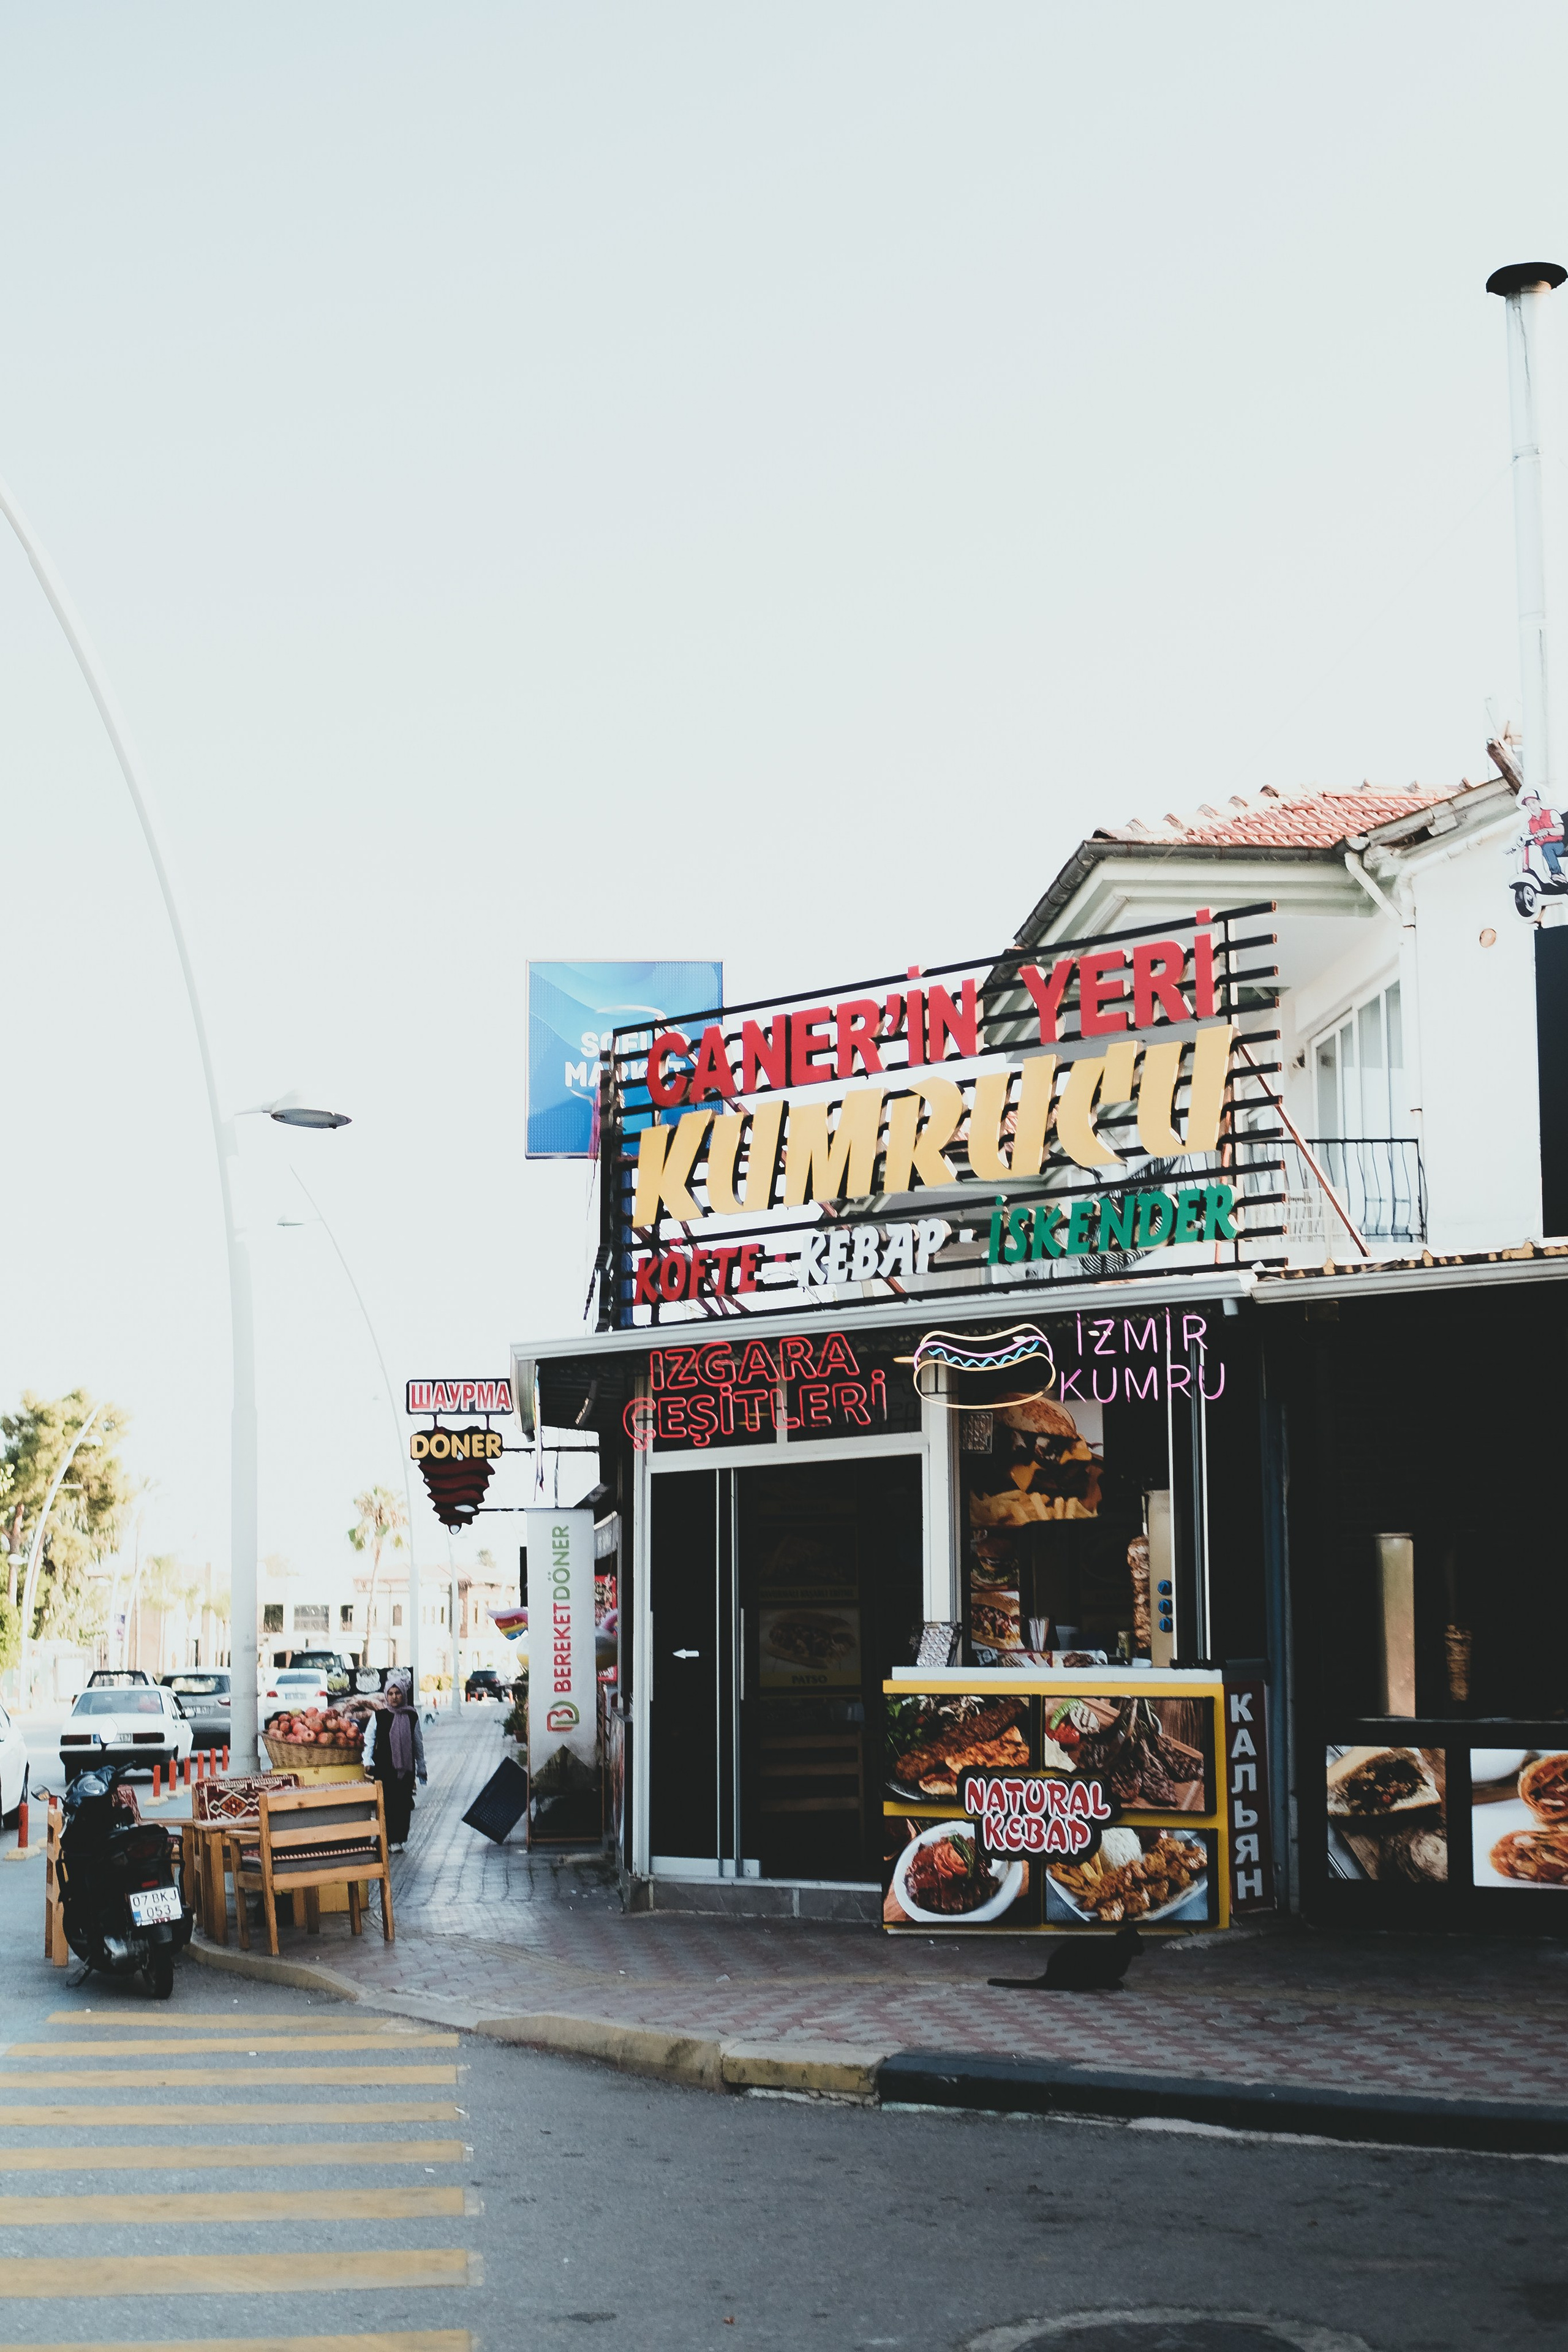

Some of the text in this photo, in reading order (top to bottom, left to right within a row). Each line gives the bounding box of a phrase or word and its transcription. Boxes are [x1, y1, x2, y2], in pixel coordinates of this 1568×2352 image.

[647, 907, 1218, 1107] CANER'İN YERİ
[632, 1024, 1234, 1227] KUMRUCU
[634, 1238, 761, 1305] KÖFTE
[800, 1218, 947, 1287] KEBAP
[987, 1184, 1238, 1265] İSKENDER
[1076, 1307, 1208, 1356] İZMİR
[649, 1333, 860, 1391] IZGARA
[1060, 1362, 1225, 1403] KUMRU
[409, 1381, 513, 1412] ШАУРМА
[623, 1370, 887, 1450] ÇEŞİTLERİ
[411, 1433, 502, 1458] DONER
[965, 1777, 1111, 1820] NATURAL
[1230, 1692, 1263, 1900] КАЛЬЯН
[982, 1814, 1091, 1855] KEBAP
[133, 1890, 177, 1907] 07 BKJ
[146, 1904, 171, 1918] 053
